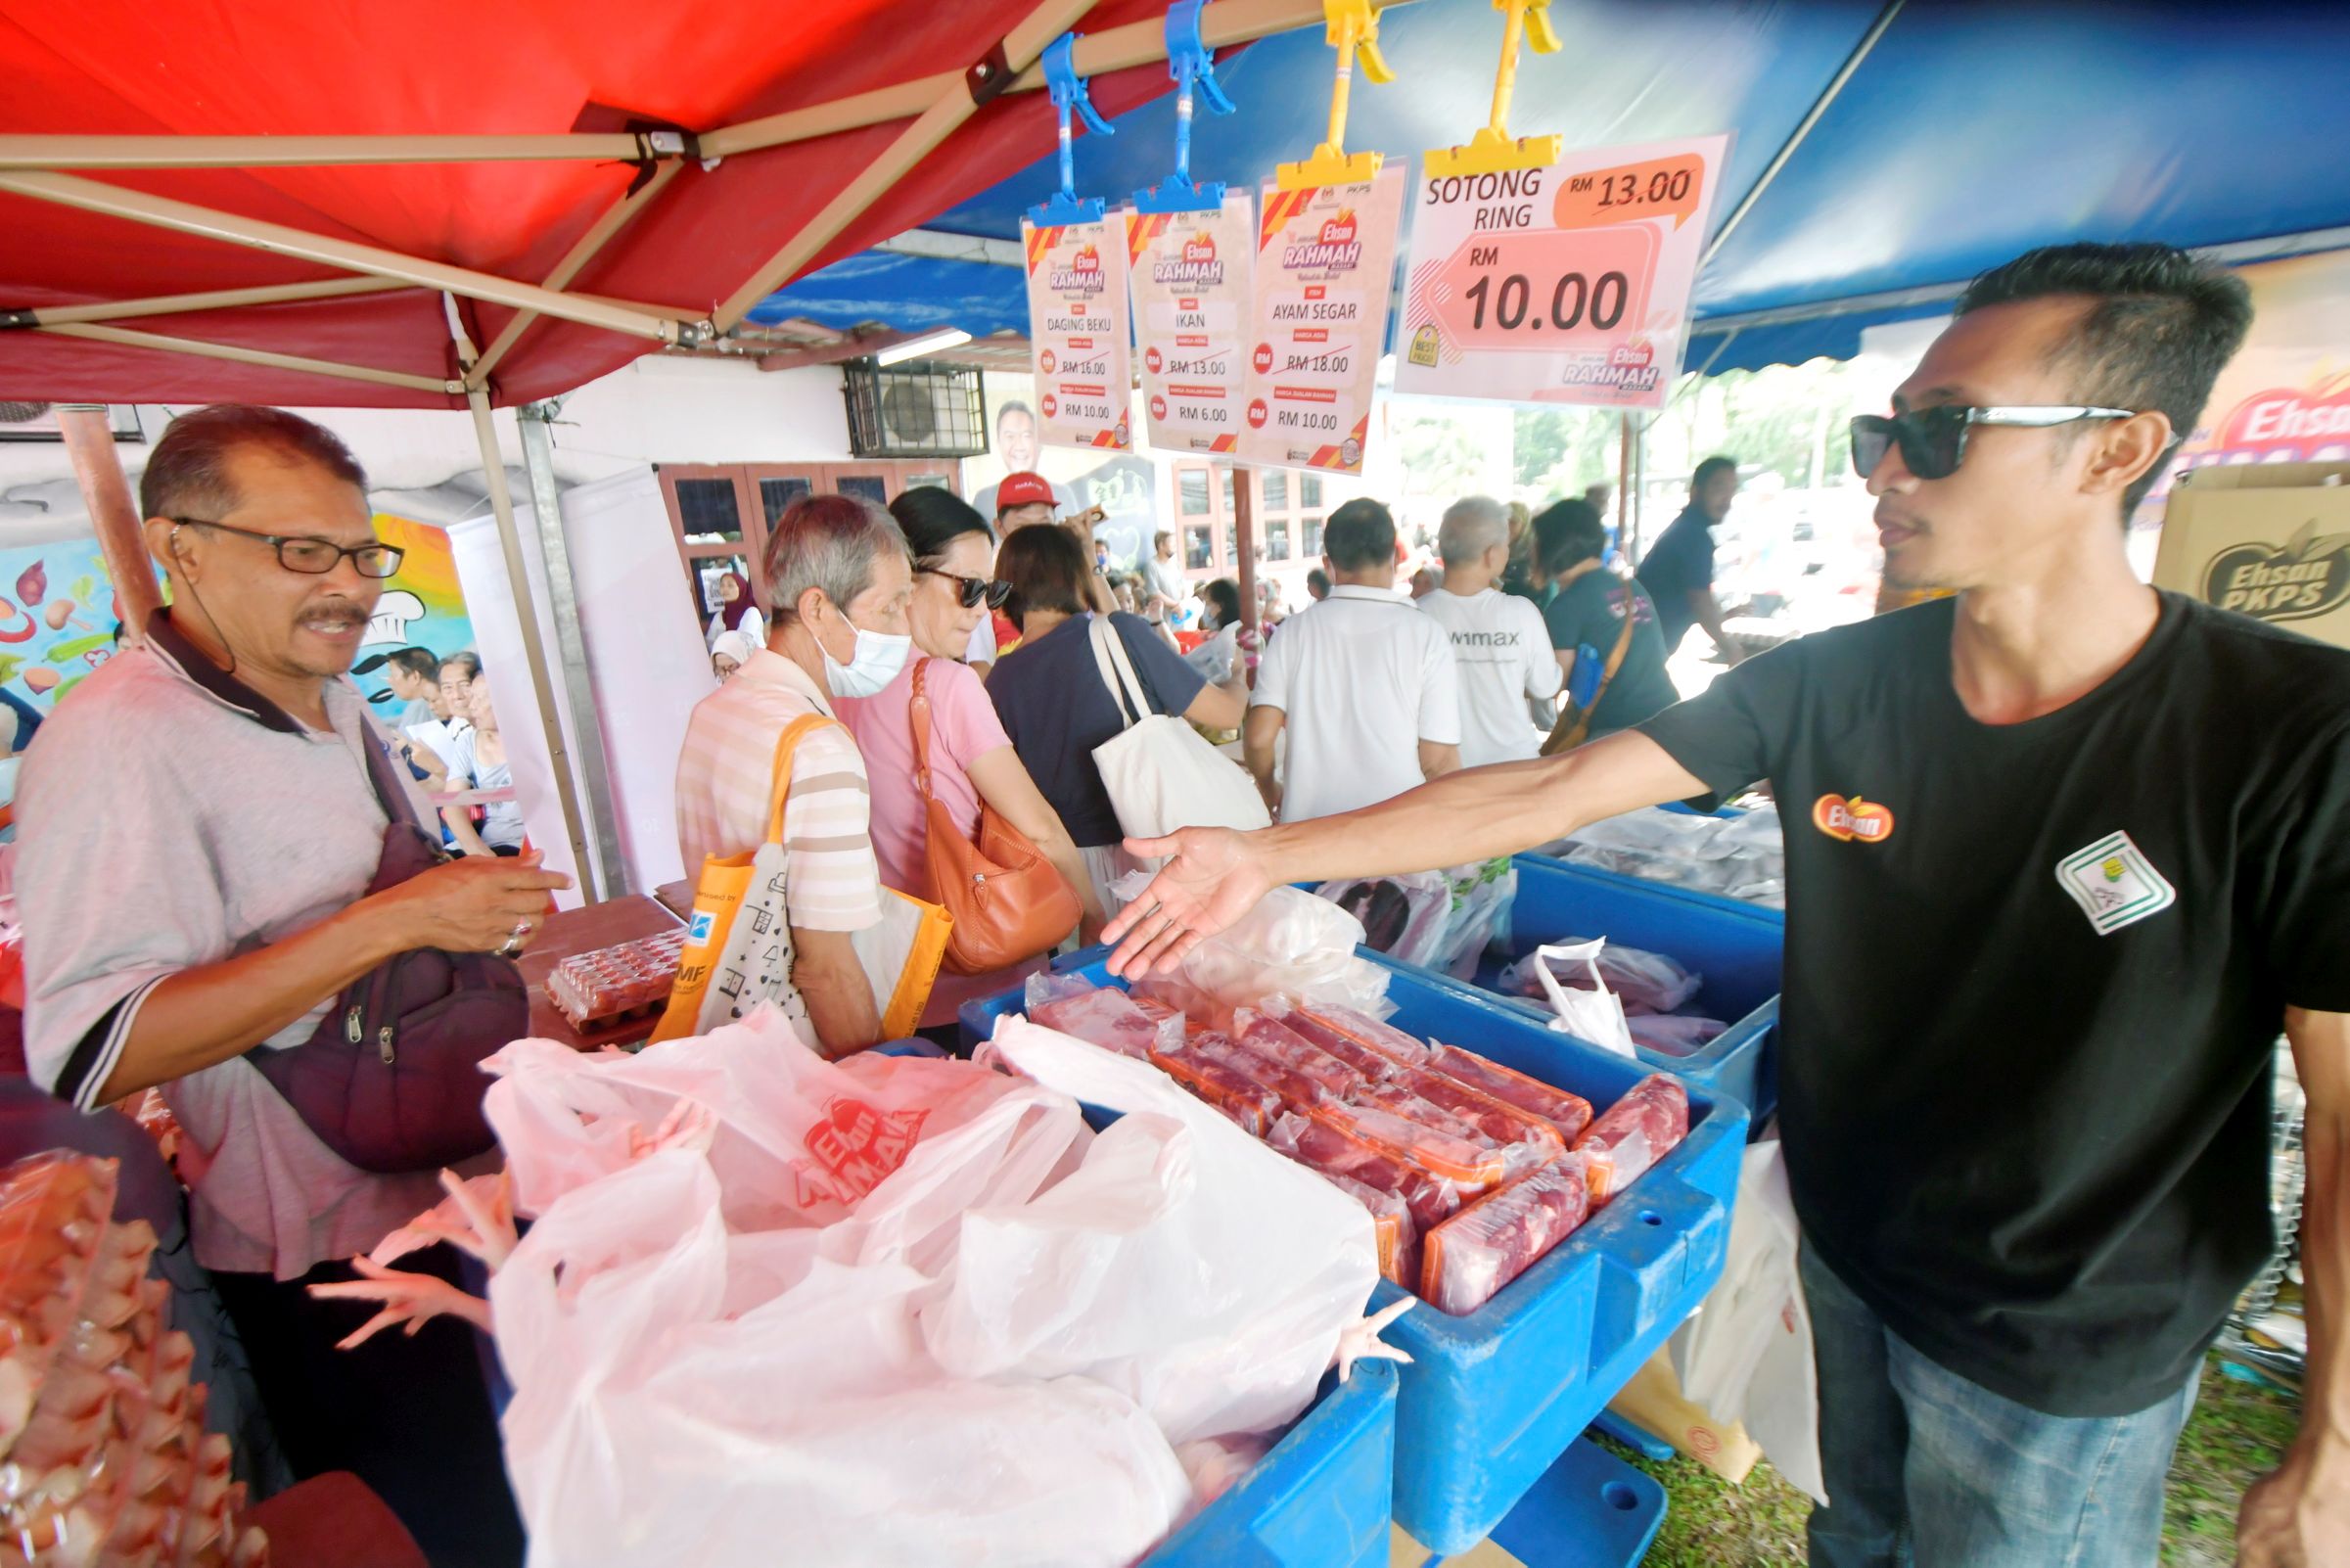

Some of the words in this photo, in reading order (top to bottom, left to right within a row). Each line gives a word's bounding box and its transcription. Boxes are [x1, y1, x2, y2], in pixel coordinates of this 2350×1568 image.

[1426, 167, 1543, 205] SOTONG
[1570, 177, 1593, 193] RM
[1597, 168, 1692, 207] 13.00
[1474, 205, 1533, 230] RING
[1323, 224, 1353, 241] Ehsan
[1283, 241, 1361, 269] RAHMAH
[1470, 247, 1498, 267] RM
[1051, 270, 1104, 290] RAHMAH
[1155, 260, 1222, 283] RAHMAH
[1465, 271, 1629, 330] 10.00
[1175, 313, 1206, 328] IKAN
[1272, 303, 1309, 320] AYAM
[1313, 303, 1358, 320] SEGAR
[1047, 318, 1084, 332] DAGING
[1086, 318, 1112, 332] BEKU
[1256, 352, 1271, 364] RM
[1287, 354, 1309, 371] RM
[1313, 354, 1349, 373] 18.00
[1614, 347, 1649, 365] Ehsan
[1062, 360, 1079, 373] RM
[1081, 361, 1106, 375] 16.00
[1170, 360, 1189, 374] RM
[1193, 360, 1226, 375] 13.00
[1562, 364, 1659, 387] RAHMAH
[1065, 403, 1082, 417] RM
[1083, 404, 1110, 419] 10.00
[1179, 406, 1198, 420] RM
[1201, 408, 1227, 422] 6.00
[1250, 407, 1266, 419] RM
[1277, 410, 1299, 427] RM
[1302, 412, 1338, 431] 10.00
[2230, 560, 2332, 590] Ehsan
[2222, 580, 2328, 611] PKPS
